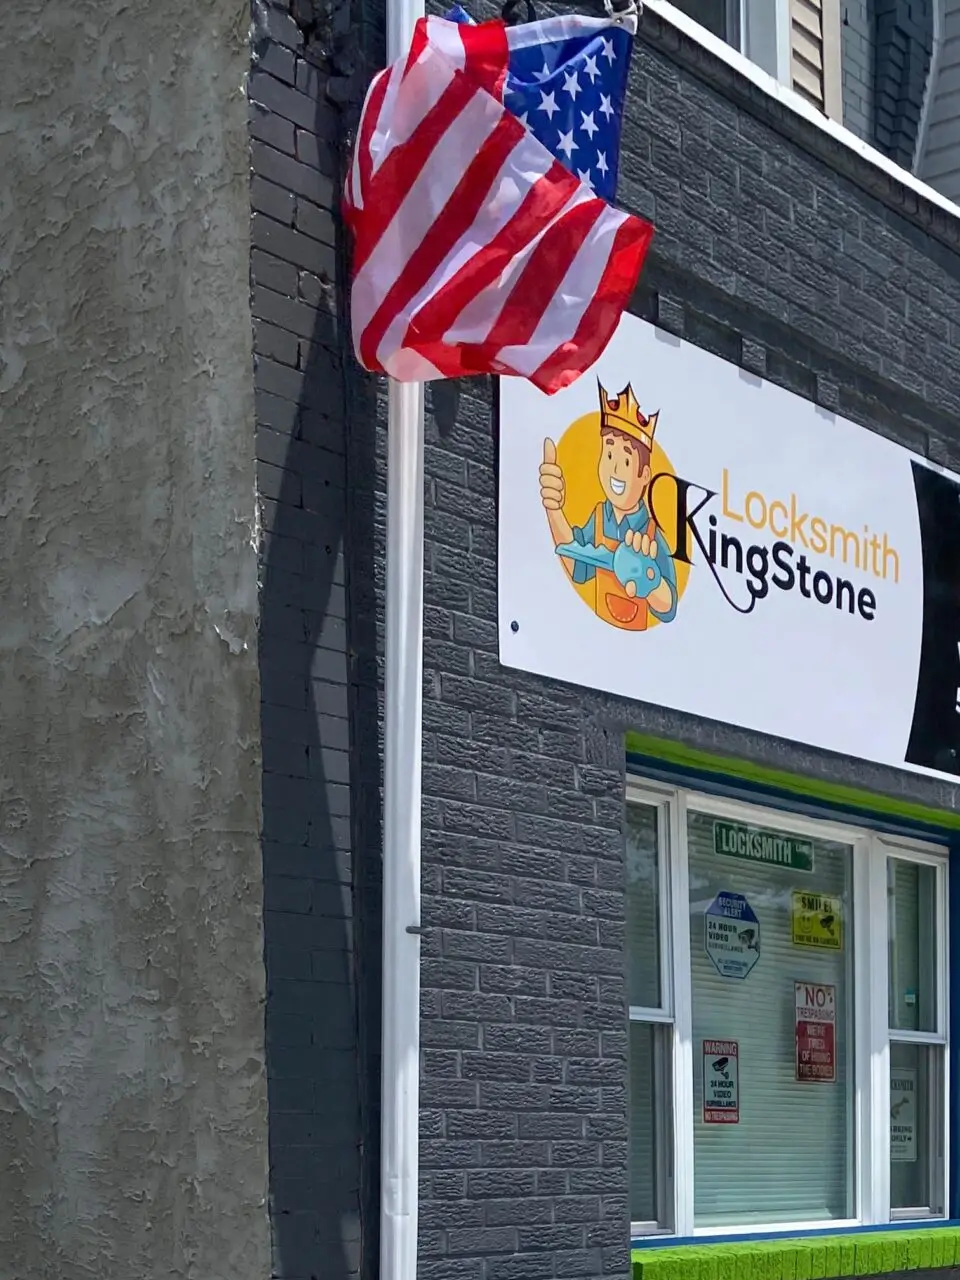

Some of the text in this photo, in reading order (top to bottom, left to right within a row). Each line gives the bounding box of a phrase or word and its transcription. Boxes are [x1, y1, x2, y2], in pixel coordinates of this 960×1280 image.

[722, 468, 900, 584] Locksmith
[648, 472, 878, 622] KingStone
[721, 827, 793, 864] LOCKSMITH
[719, 897, 747, 910] SECURITY
[723, 907, 743, 918] ALERT
[718, 923, 738, 934] HOUR
[708, 931, 730, 943] VIDEO
[805, 986, 826, 1007] NO
[704, 1041, 737, 1055] WARNING
[801, 1050, 811, 1062] OF
[713, 1090, 732, 1099] VIDEO
